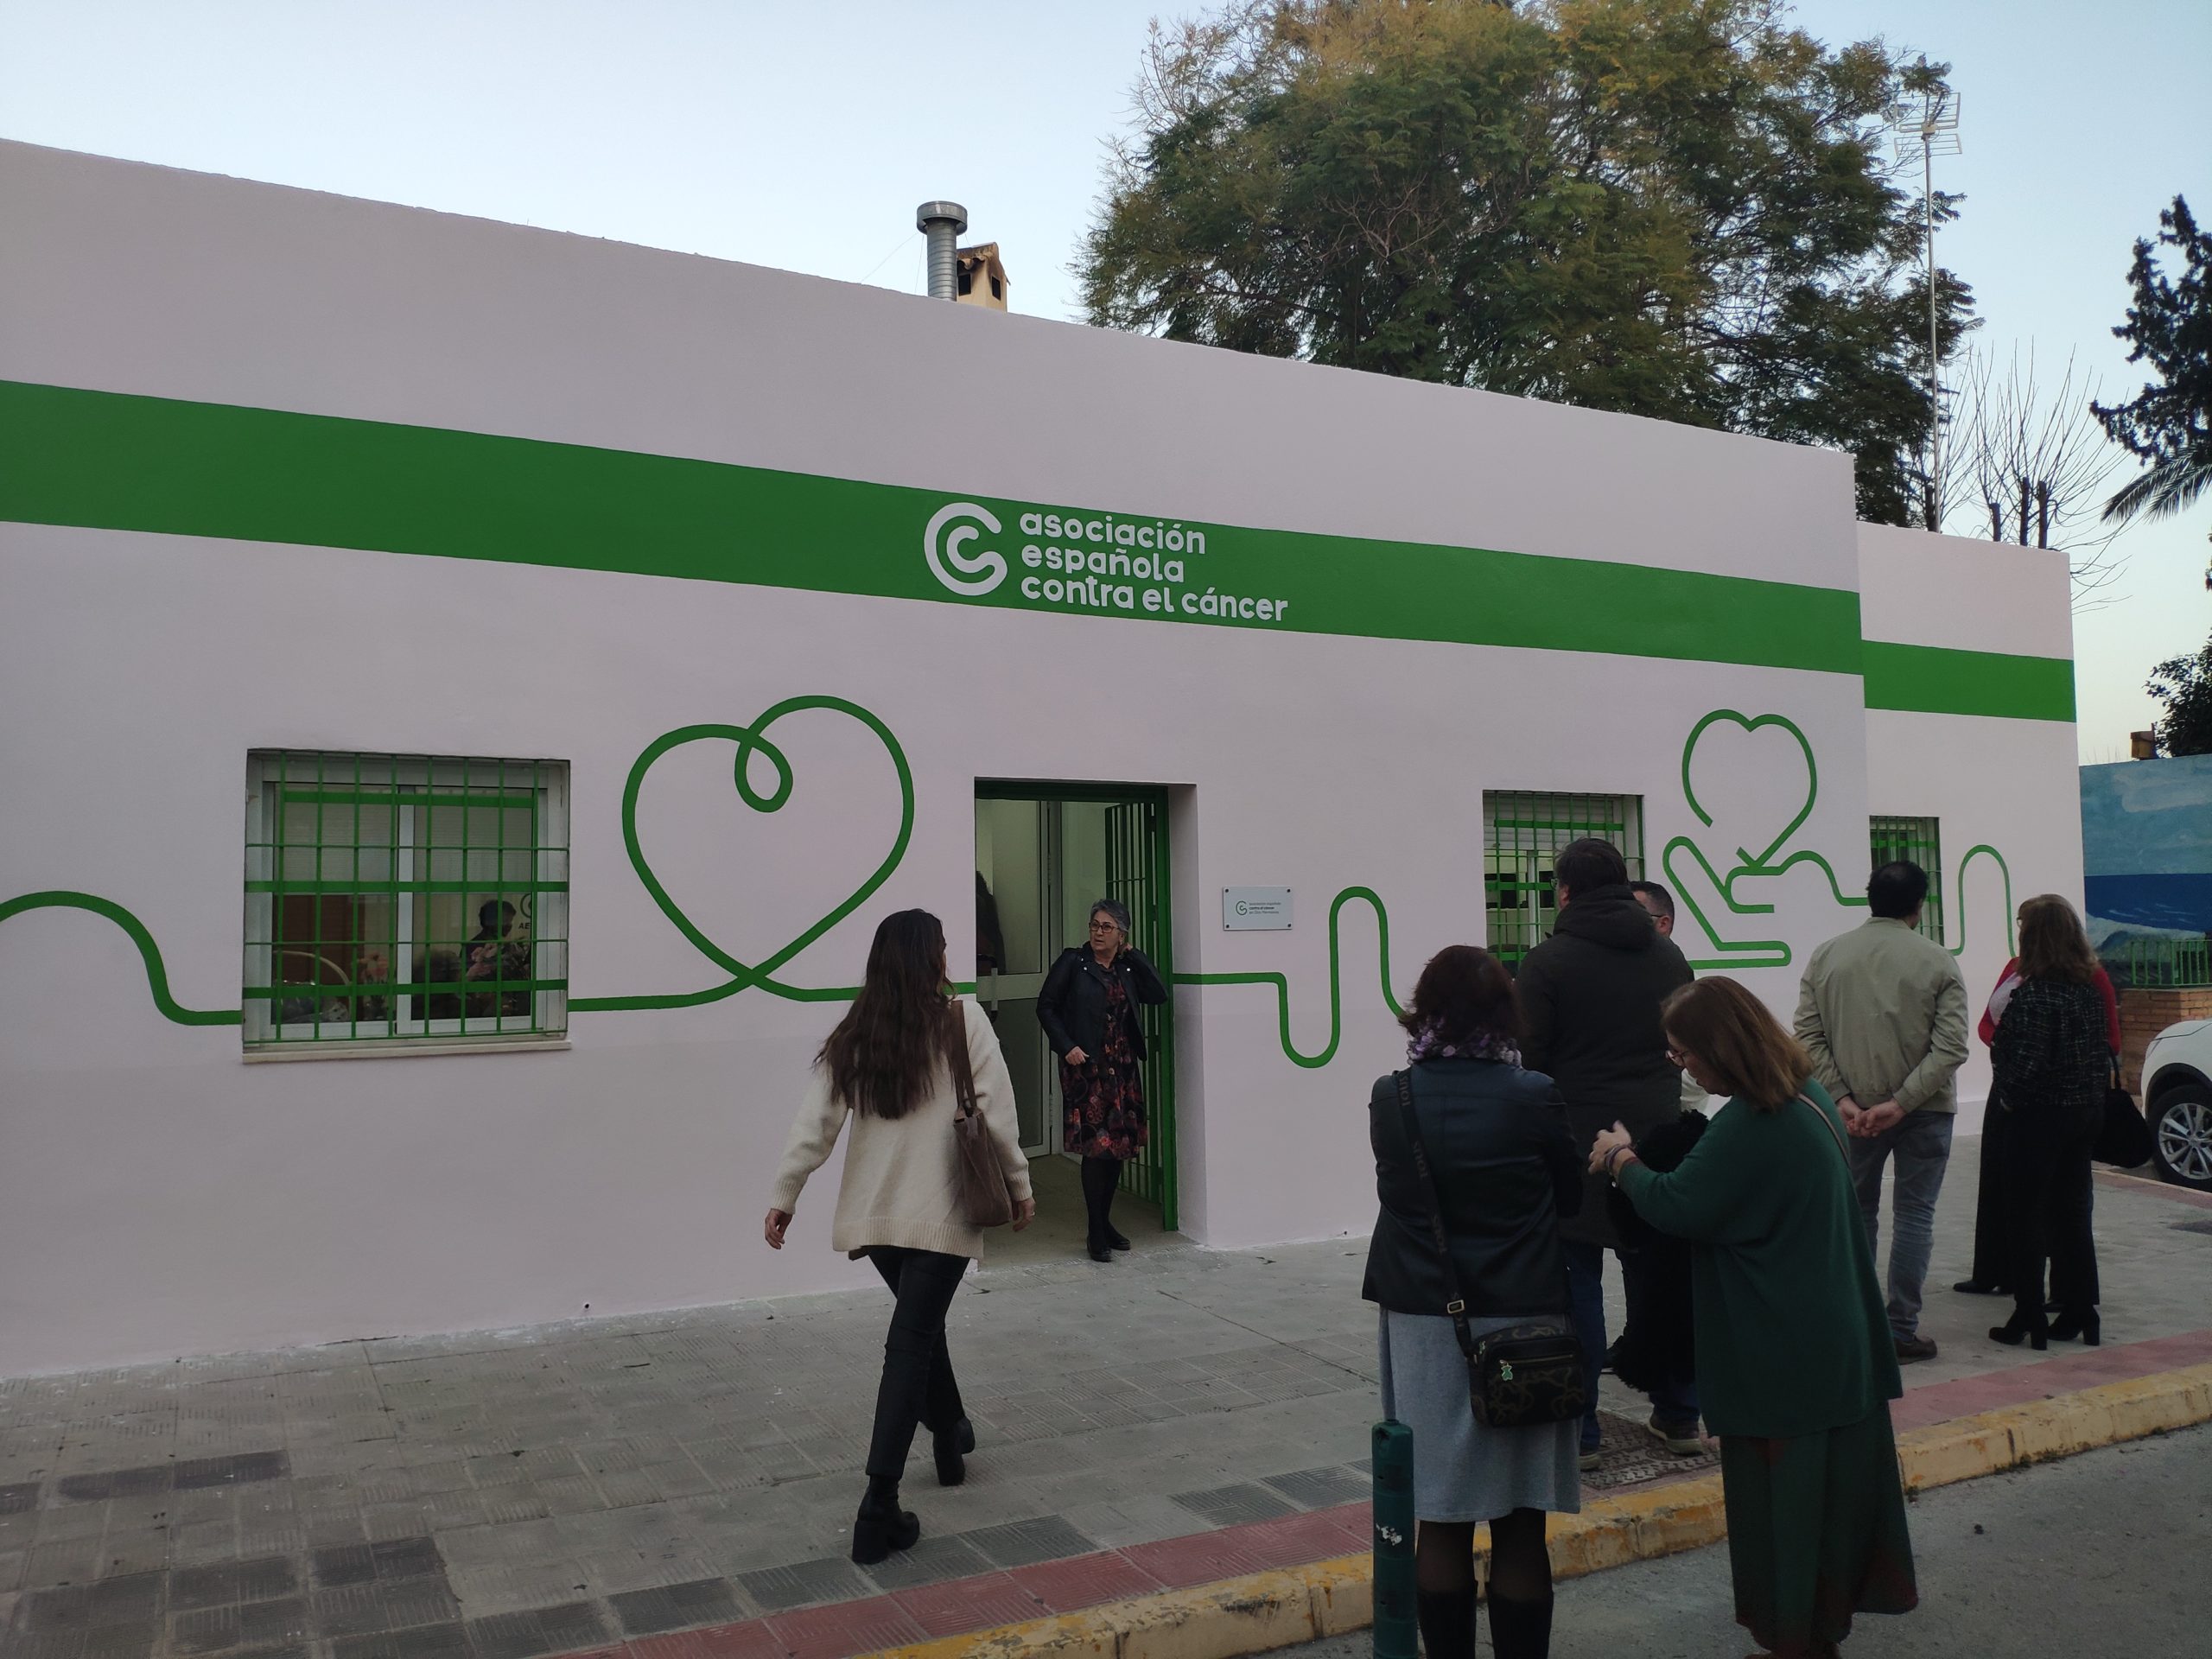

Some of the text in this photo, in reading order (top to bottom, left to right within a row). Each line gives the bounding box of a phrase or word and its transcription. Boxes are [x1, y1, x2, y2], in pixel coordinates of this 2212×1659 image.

[1019, 512, 1206, 555] asociación
[1021, 544, 1185, 583] española
[1020, 575, 1288, 621] contra el cáncer
